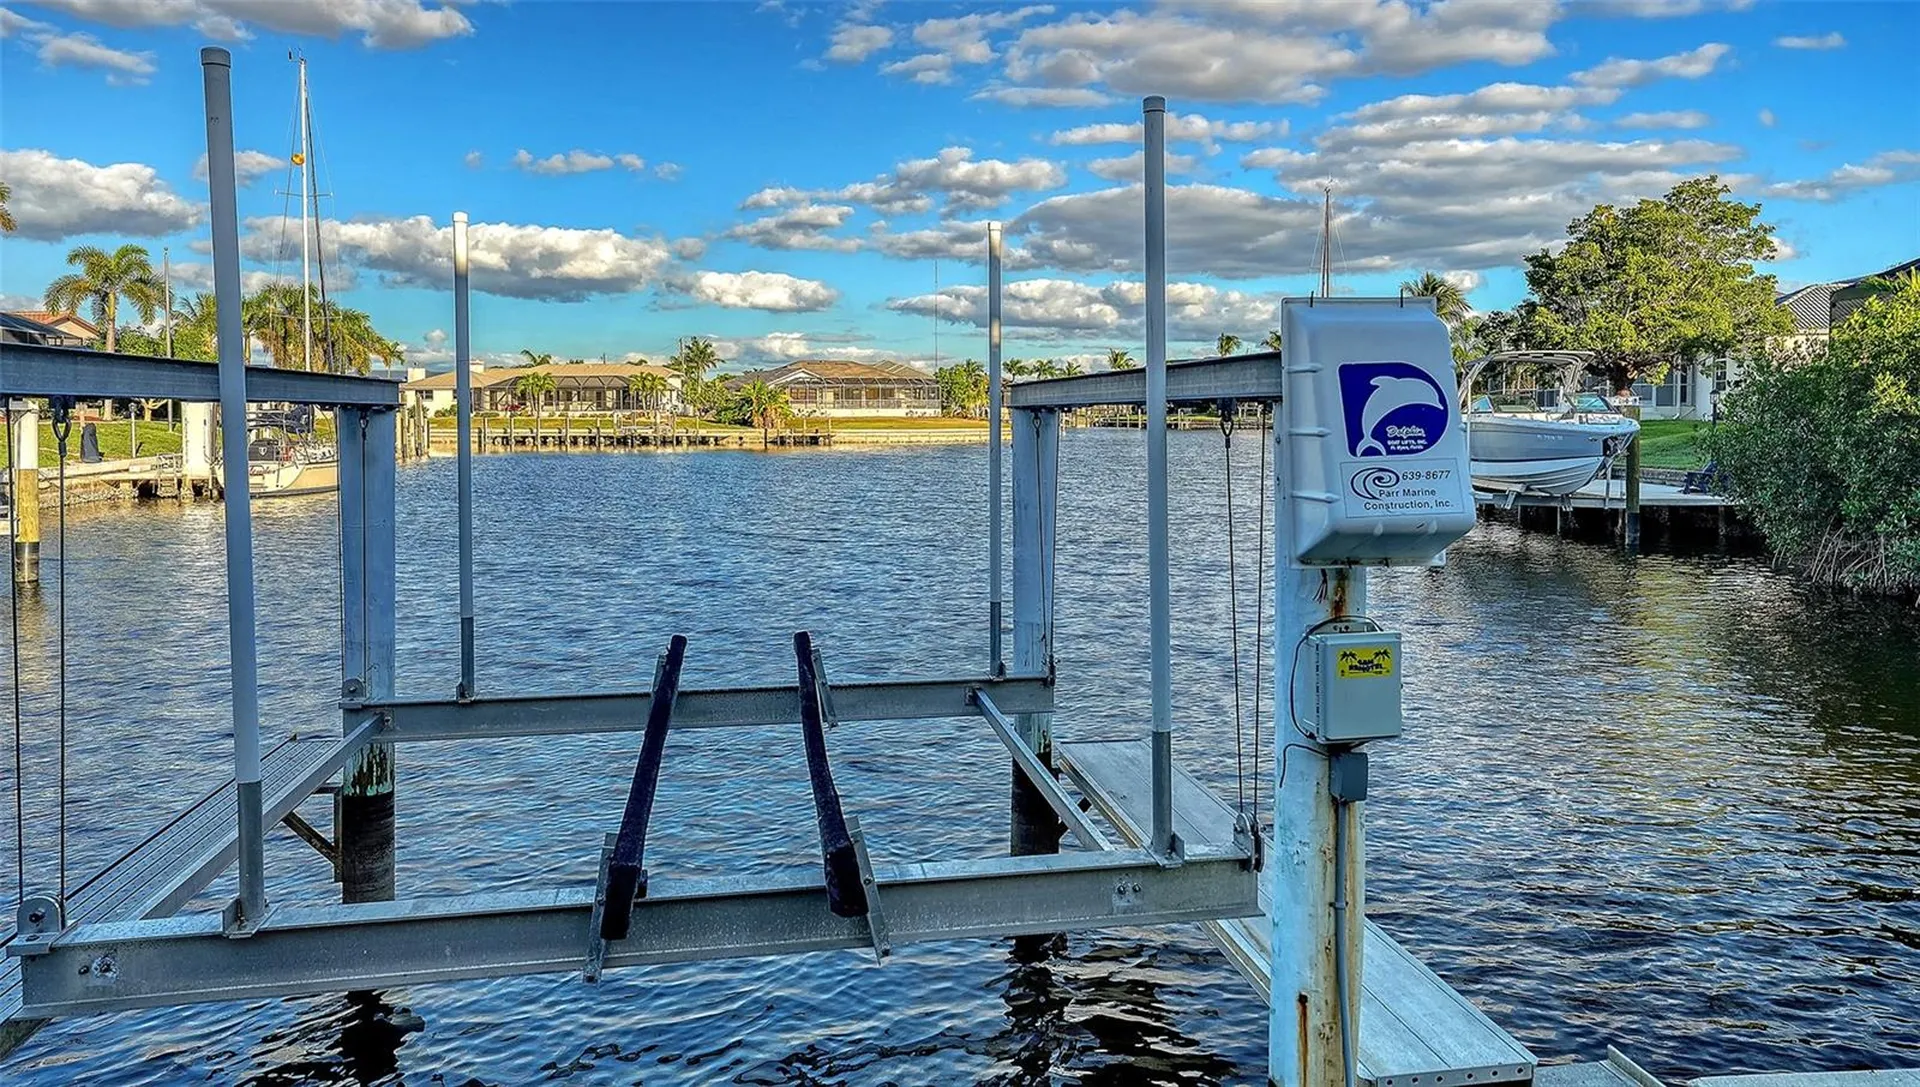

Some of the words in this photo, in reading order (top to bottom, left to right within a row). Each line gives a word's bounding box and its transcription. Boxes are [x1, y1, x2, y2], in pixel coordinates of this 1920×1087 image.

[1386, 424, 1426, 439] Dolphin
[1401, 470, 1451, 481] 639-8677
[1378, 489, 1399, 498] Parr
[1402, 488, 1437, 498] Marine
[1363, 500, 1433, 511] Construction,
[1434, 499, 1454, 508] Inc.
